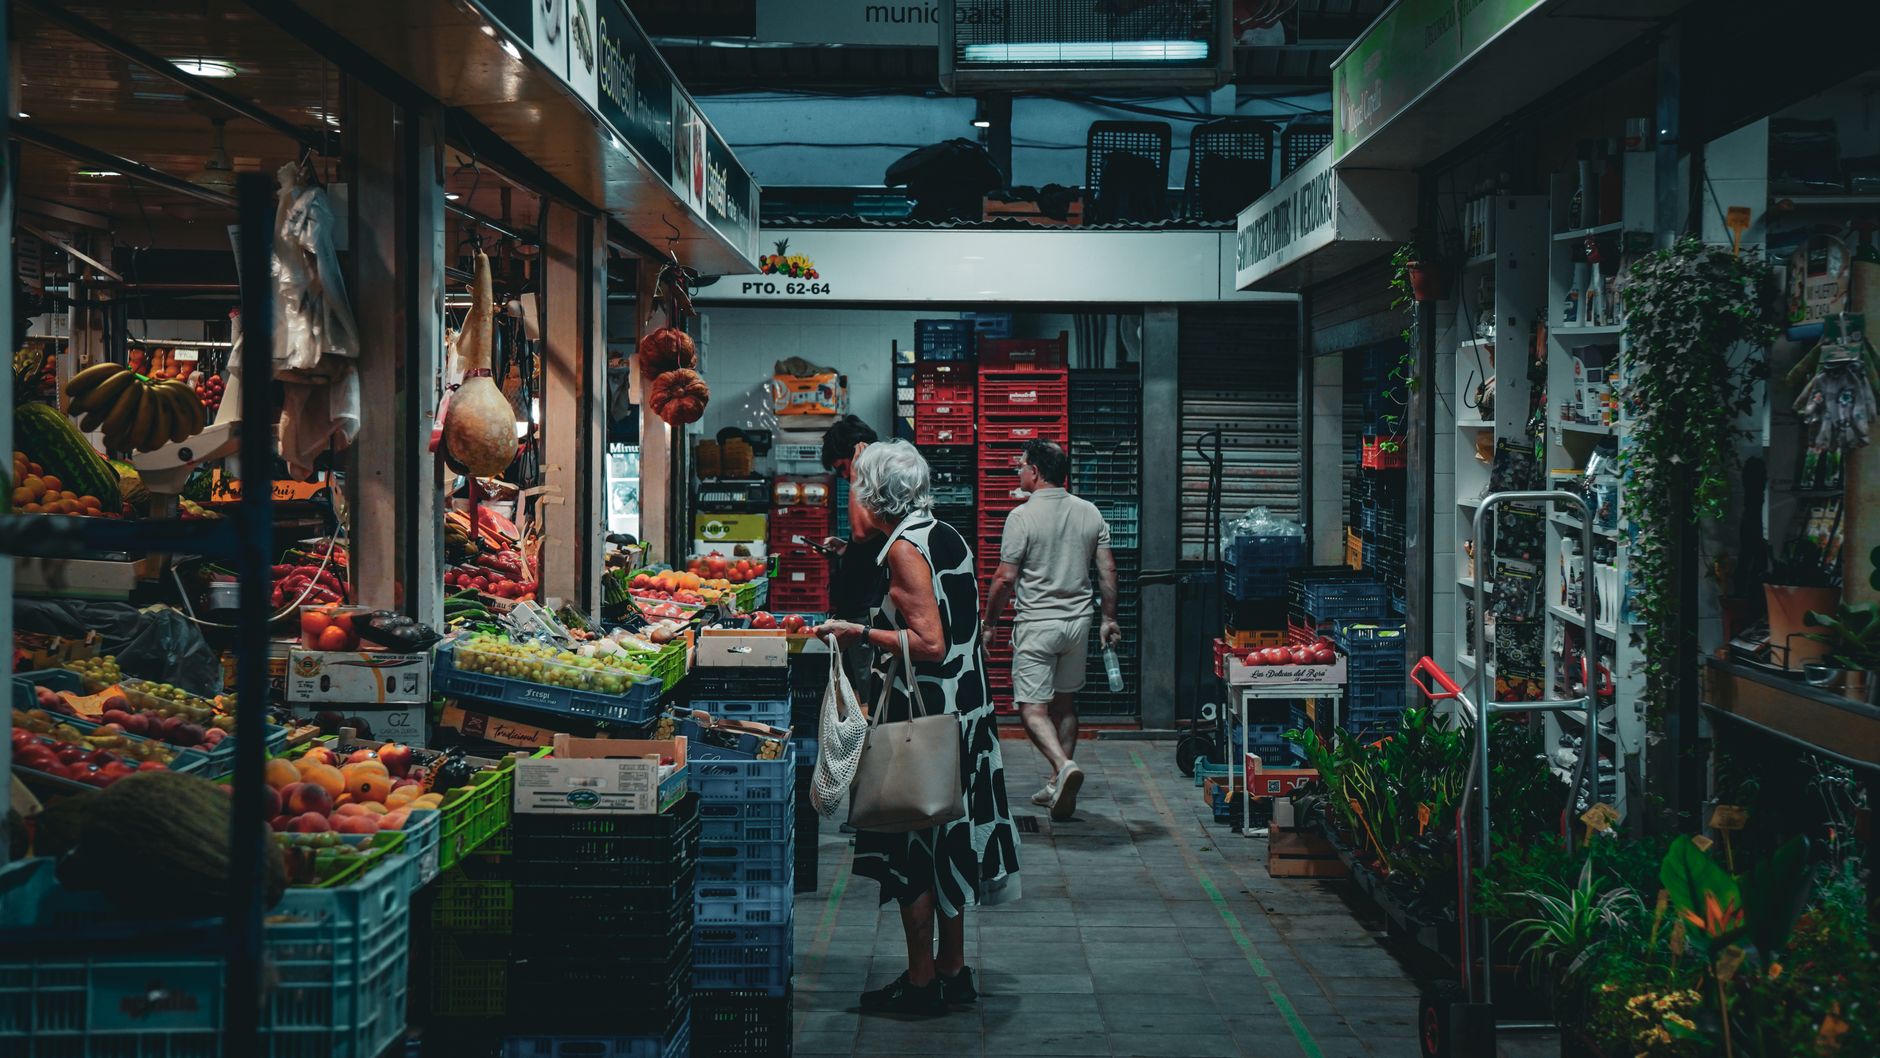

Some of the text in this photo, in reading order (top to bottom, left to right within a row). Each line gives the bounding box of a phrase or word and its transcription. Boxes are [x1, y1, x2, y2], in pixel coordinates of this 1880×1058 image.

[1293, 191, 1298, 241] Y
[1300, 167, 1333, 238] VERDURAS
[742, 282, 830, 295] PTO. 62-64
[388, 712, 411, 728] GZ
